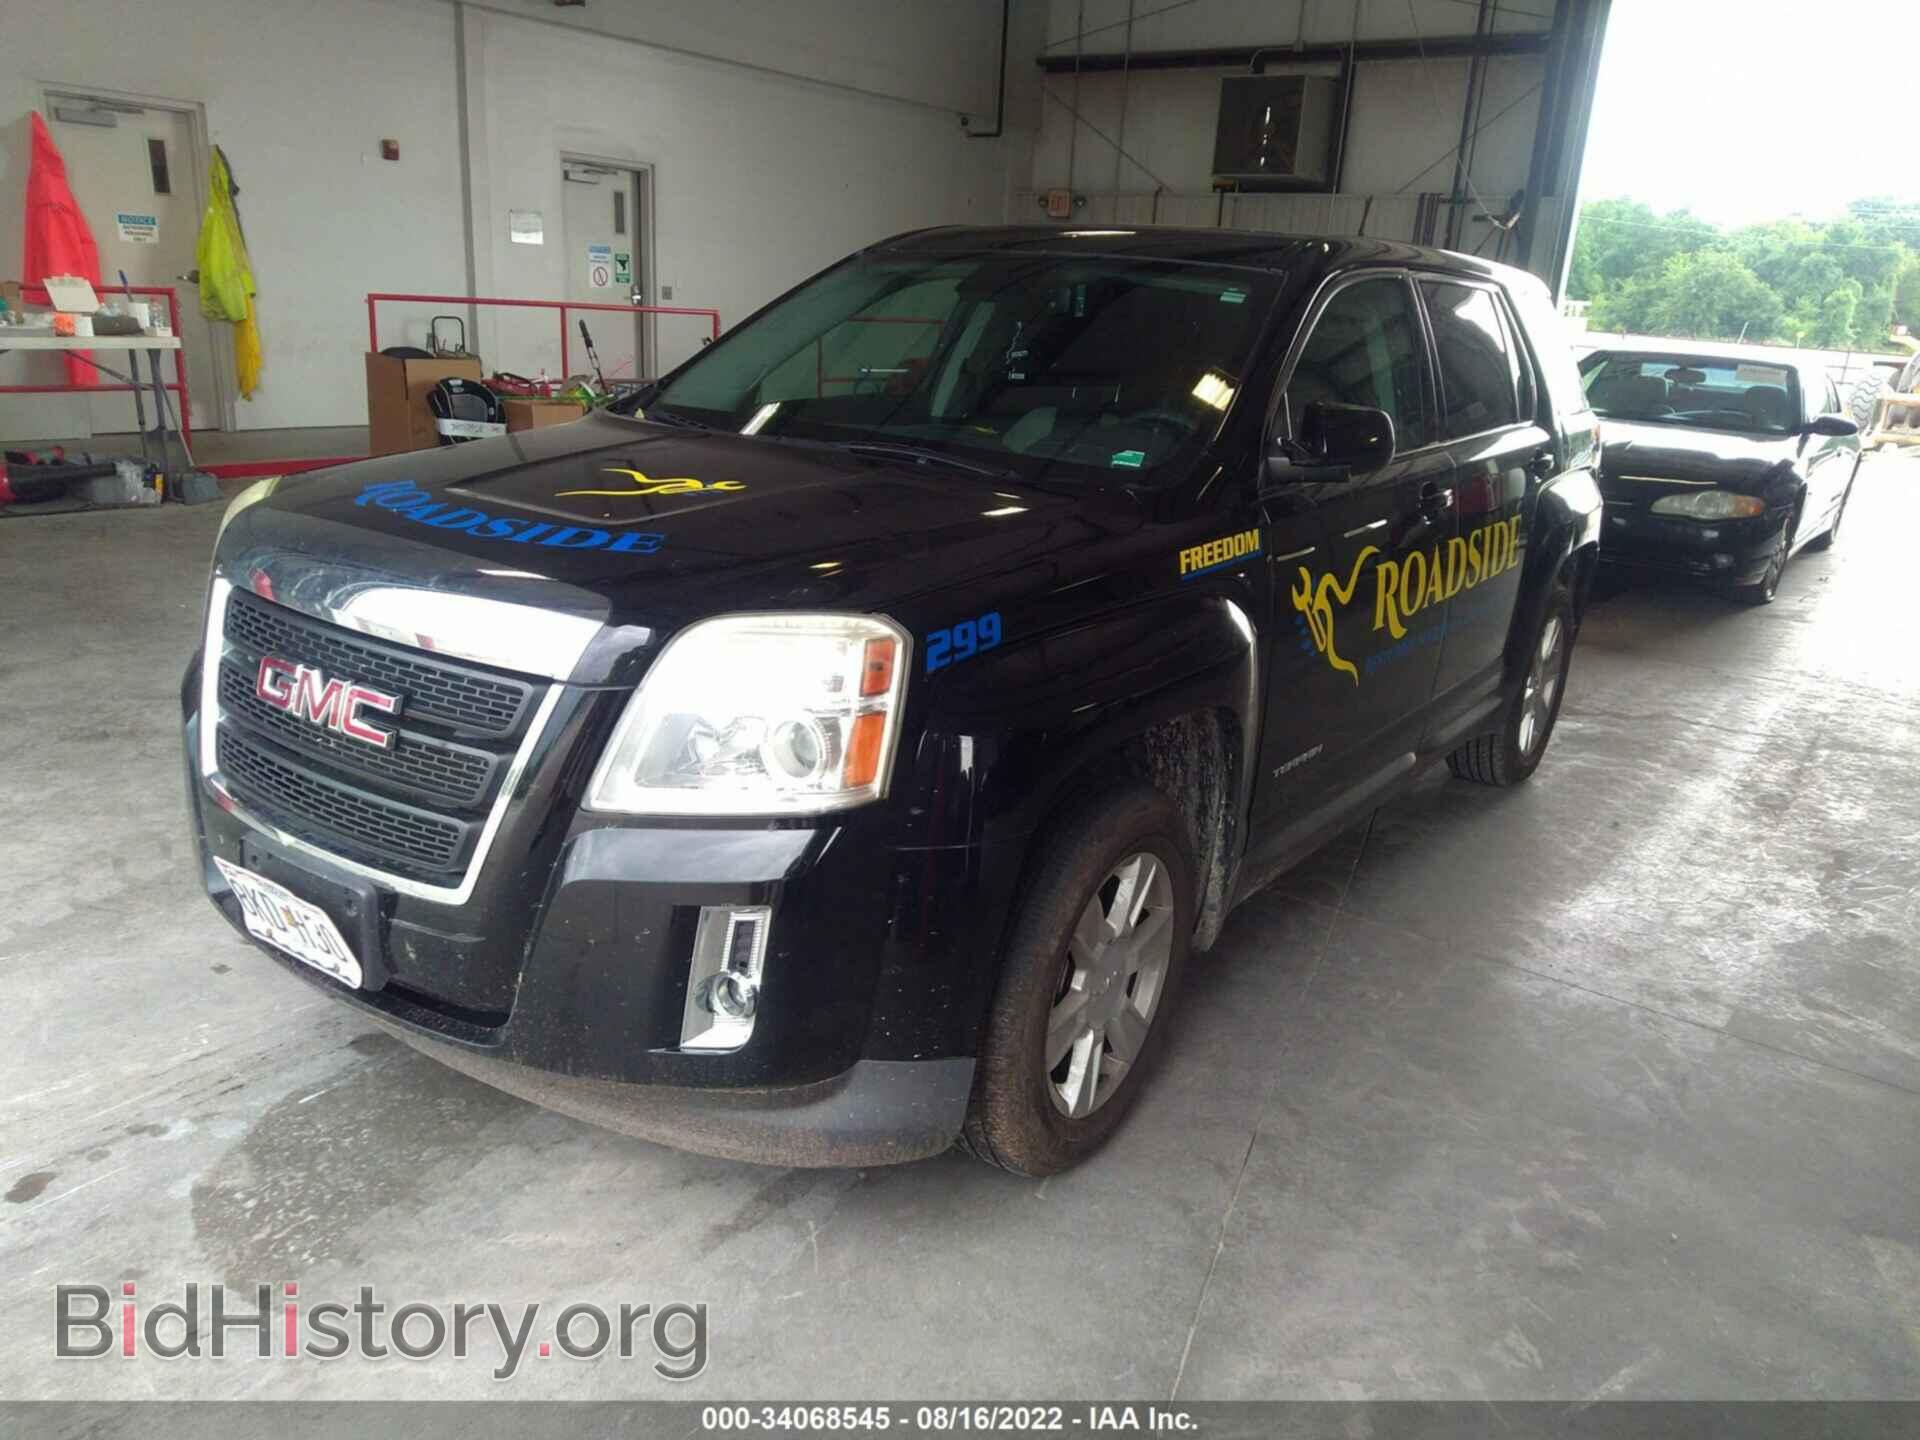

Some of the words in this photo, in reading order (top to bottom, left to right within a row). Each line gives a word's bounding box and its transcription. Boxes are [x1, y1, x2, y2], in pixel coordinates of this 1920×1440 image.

[354, 479, 666, 553] ROADSIDE
[1180, 528, 1260, 575] FREEDOM
[1373, 514, 1522, 639] ROADSIDE
[925, 611, 1003, 674] 299
[256, 656, 404, 749] GMC
